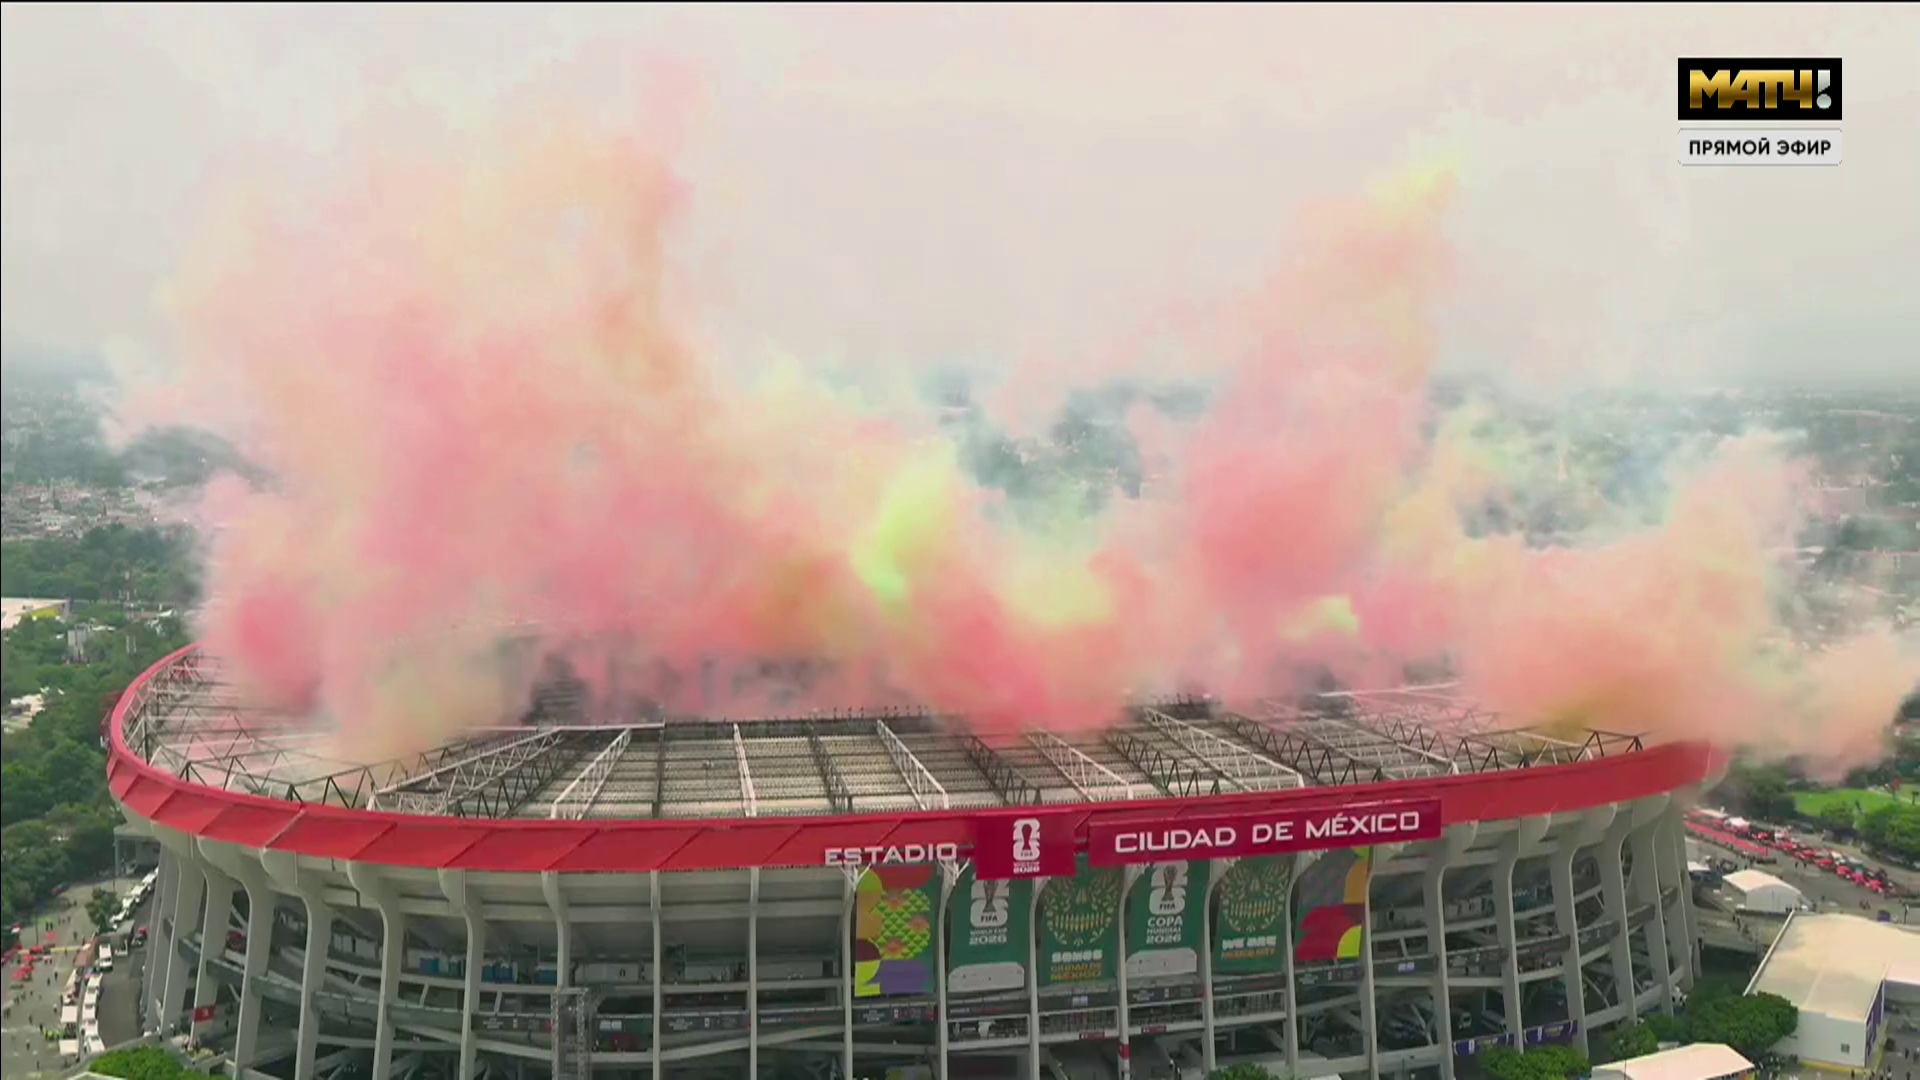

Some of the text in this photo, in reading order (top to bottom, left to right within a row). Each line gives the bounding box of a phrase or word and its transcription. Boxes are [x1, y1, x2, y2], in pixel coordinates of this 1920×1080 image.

[1115, 811, 1420, 853] CIUDAD DE MÉXICO
[824, 843, 958, 866] ESTADIO
[1159, 902, 1176, 911] FIFA
[980, 914, 998, 923] FIFA
[1147, 915, 1183, 927] COPA
[969, 935, 1007, 945] 2026
[1145, 934, 1182, 944] 2026
